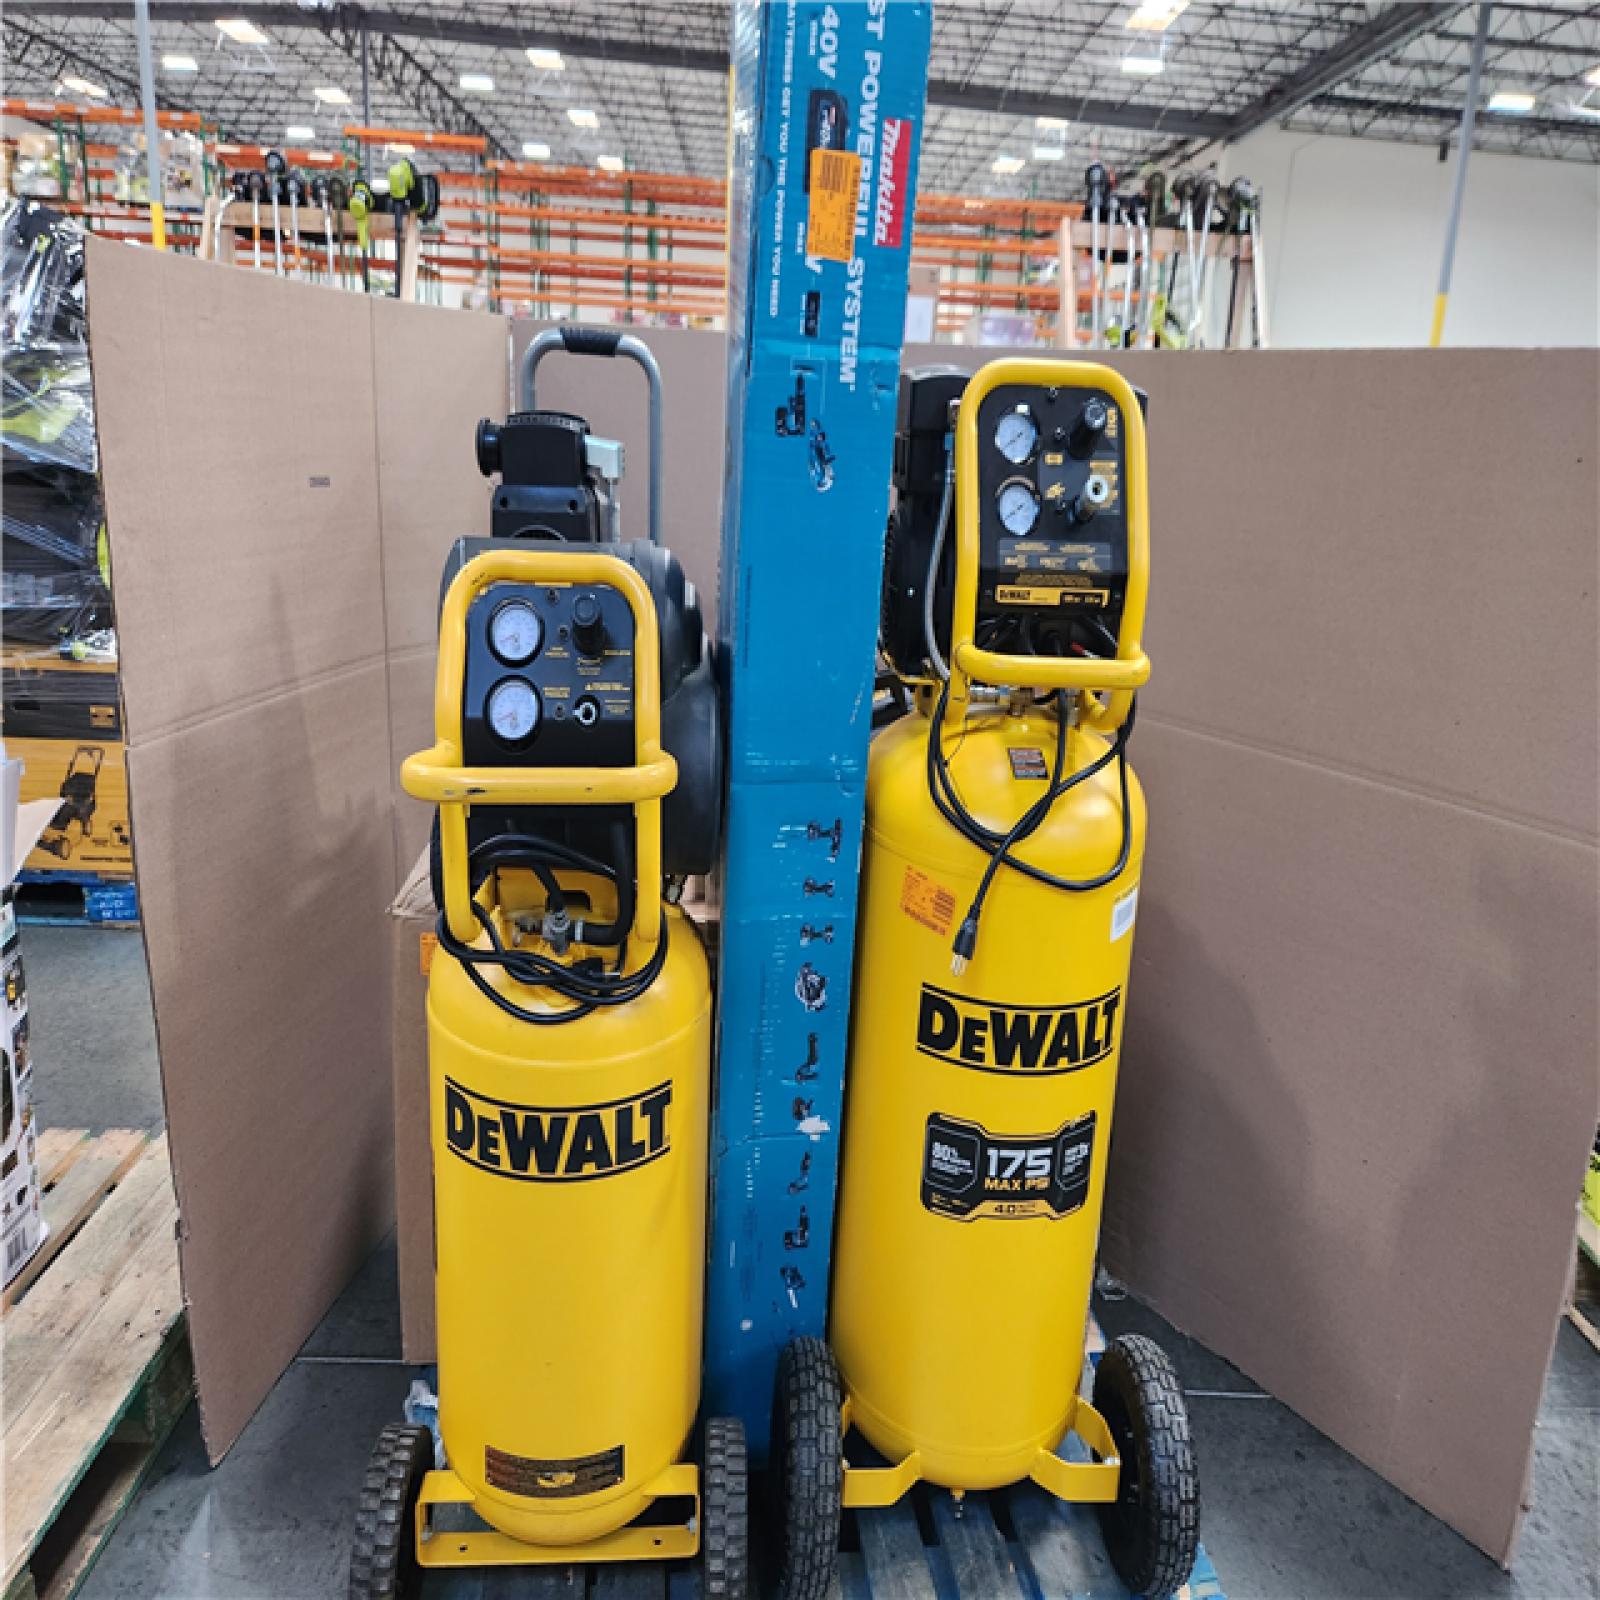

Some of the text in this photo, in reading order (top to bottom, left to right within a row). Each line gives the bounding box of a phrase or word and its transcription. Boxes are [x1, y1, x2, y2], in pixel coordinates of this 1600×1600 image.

[818, 4, 841, 80] 40V
[779, 122, 789, 153] YOU
[777, 157, 788, 186] THE
[774, 190, 786, 242] POWER
[772, 247, 782, 276] YOU
[769, 280, 780, 318] NEED
[840, 257, 866, 384] SYSTEM
[917, 989, 1118, 1068] DEWALT
[446, 1082, 672, 1174] DEWALT
[986, 1147, 1053, 1178] 175
[984, 1177, 1051, 1191] MAX PSI
